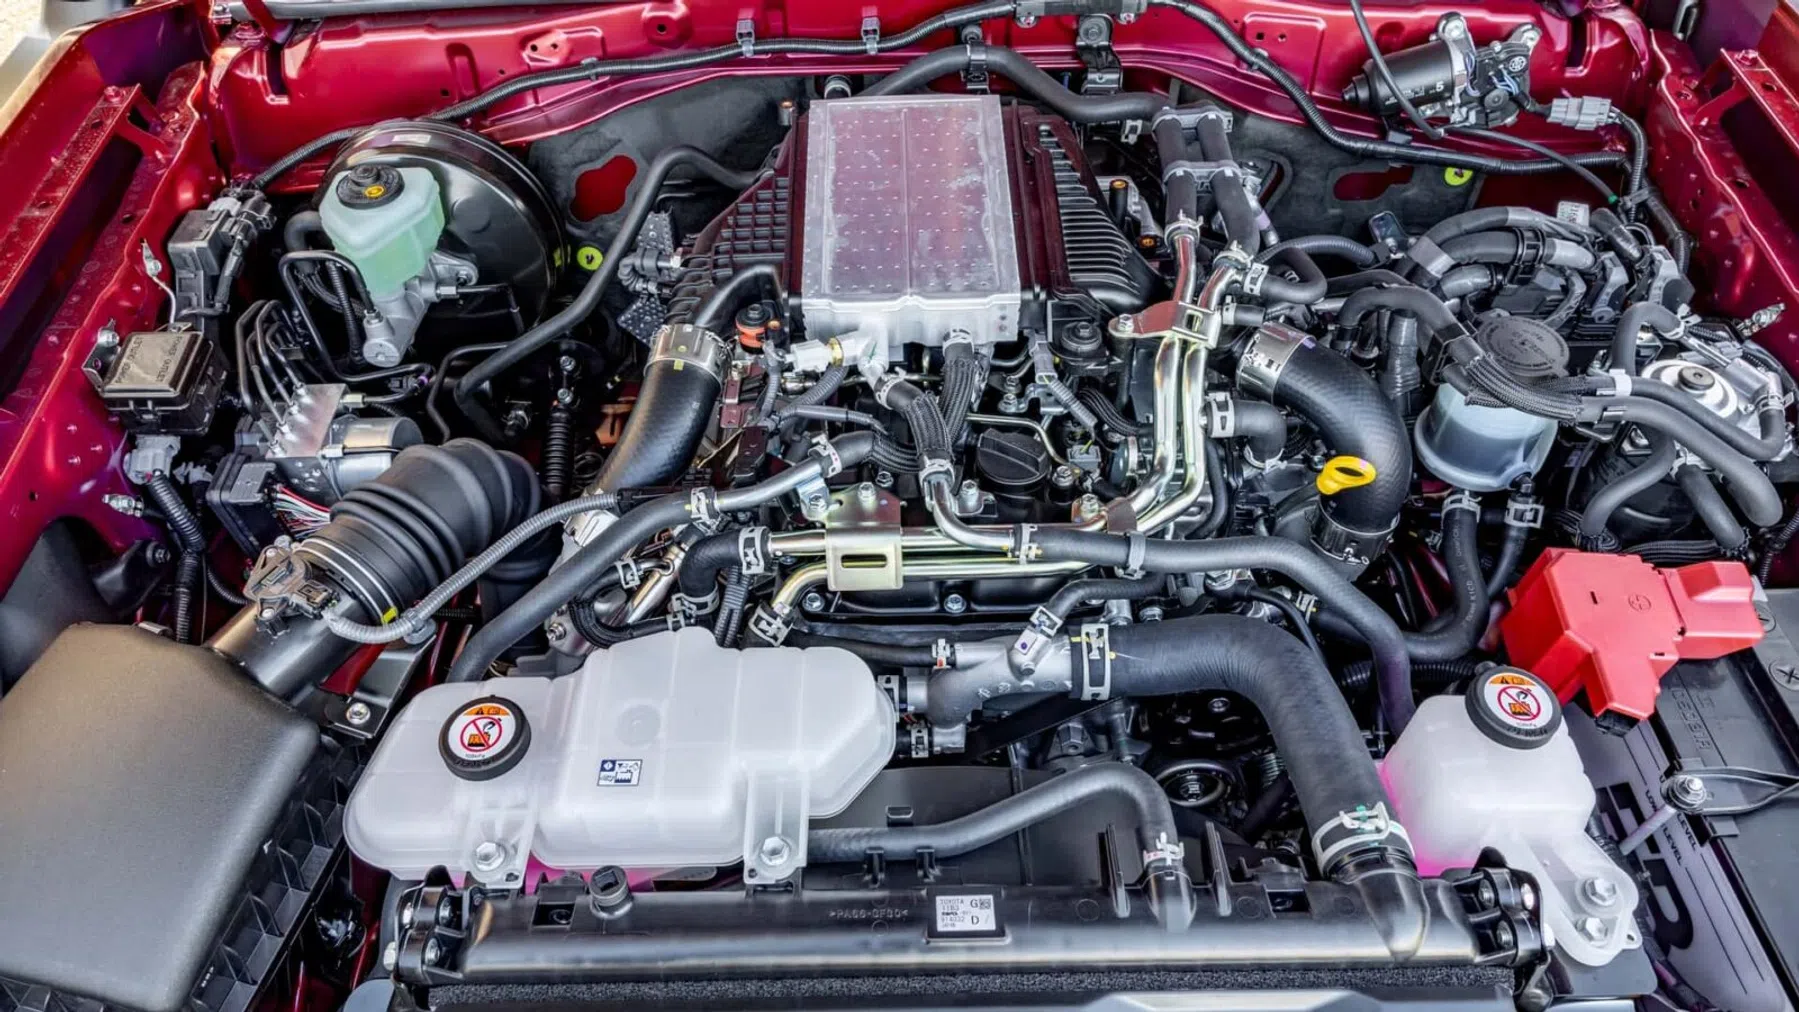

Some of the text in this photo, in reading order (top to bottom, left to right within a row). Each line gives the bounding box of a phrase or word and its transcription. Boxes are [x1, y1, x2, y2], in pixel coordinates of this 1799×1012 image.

[1677, 812, 1696, 851] LEVEL
[1662, 827, 1683, 867] LEVEL
[970, 899, 979, 909] G
[971, 915, 980, 926] D
